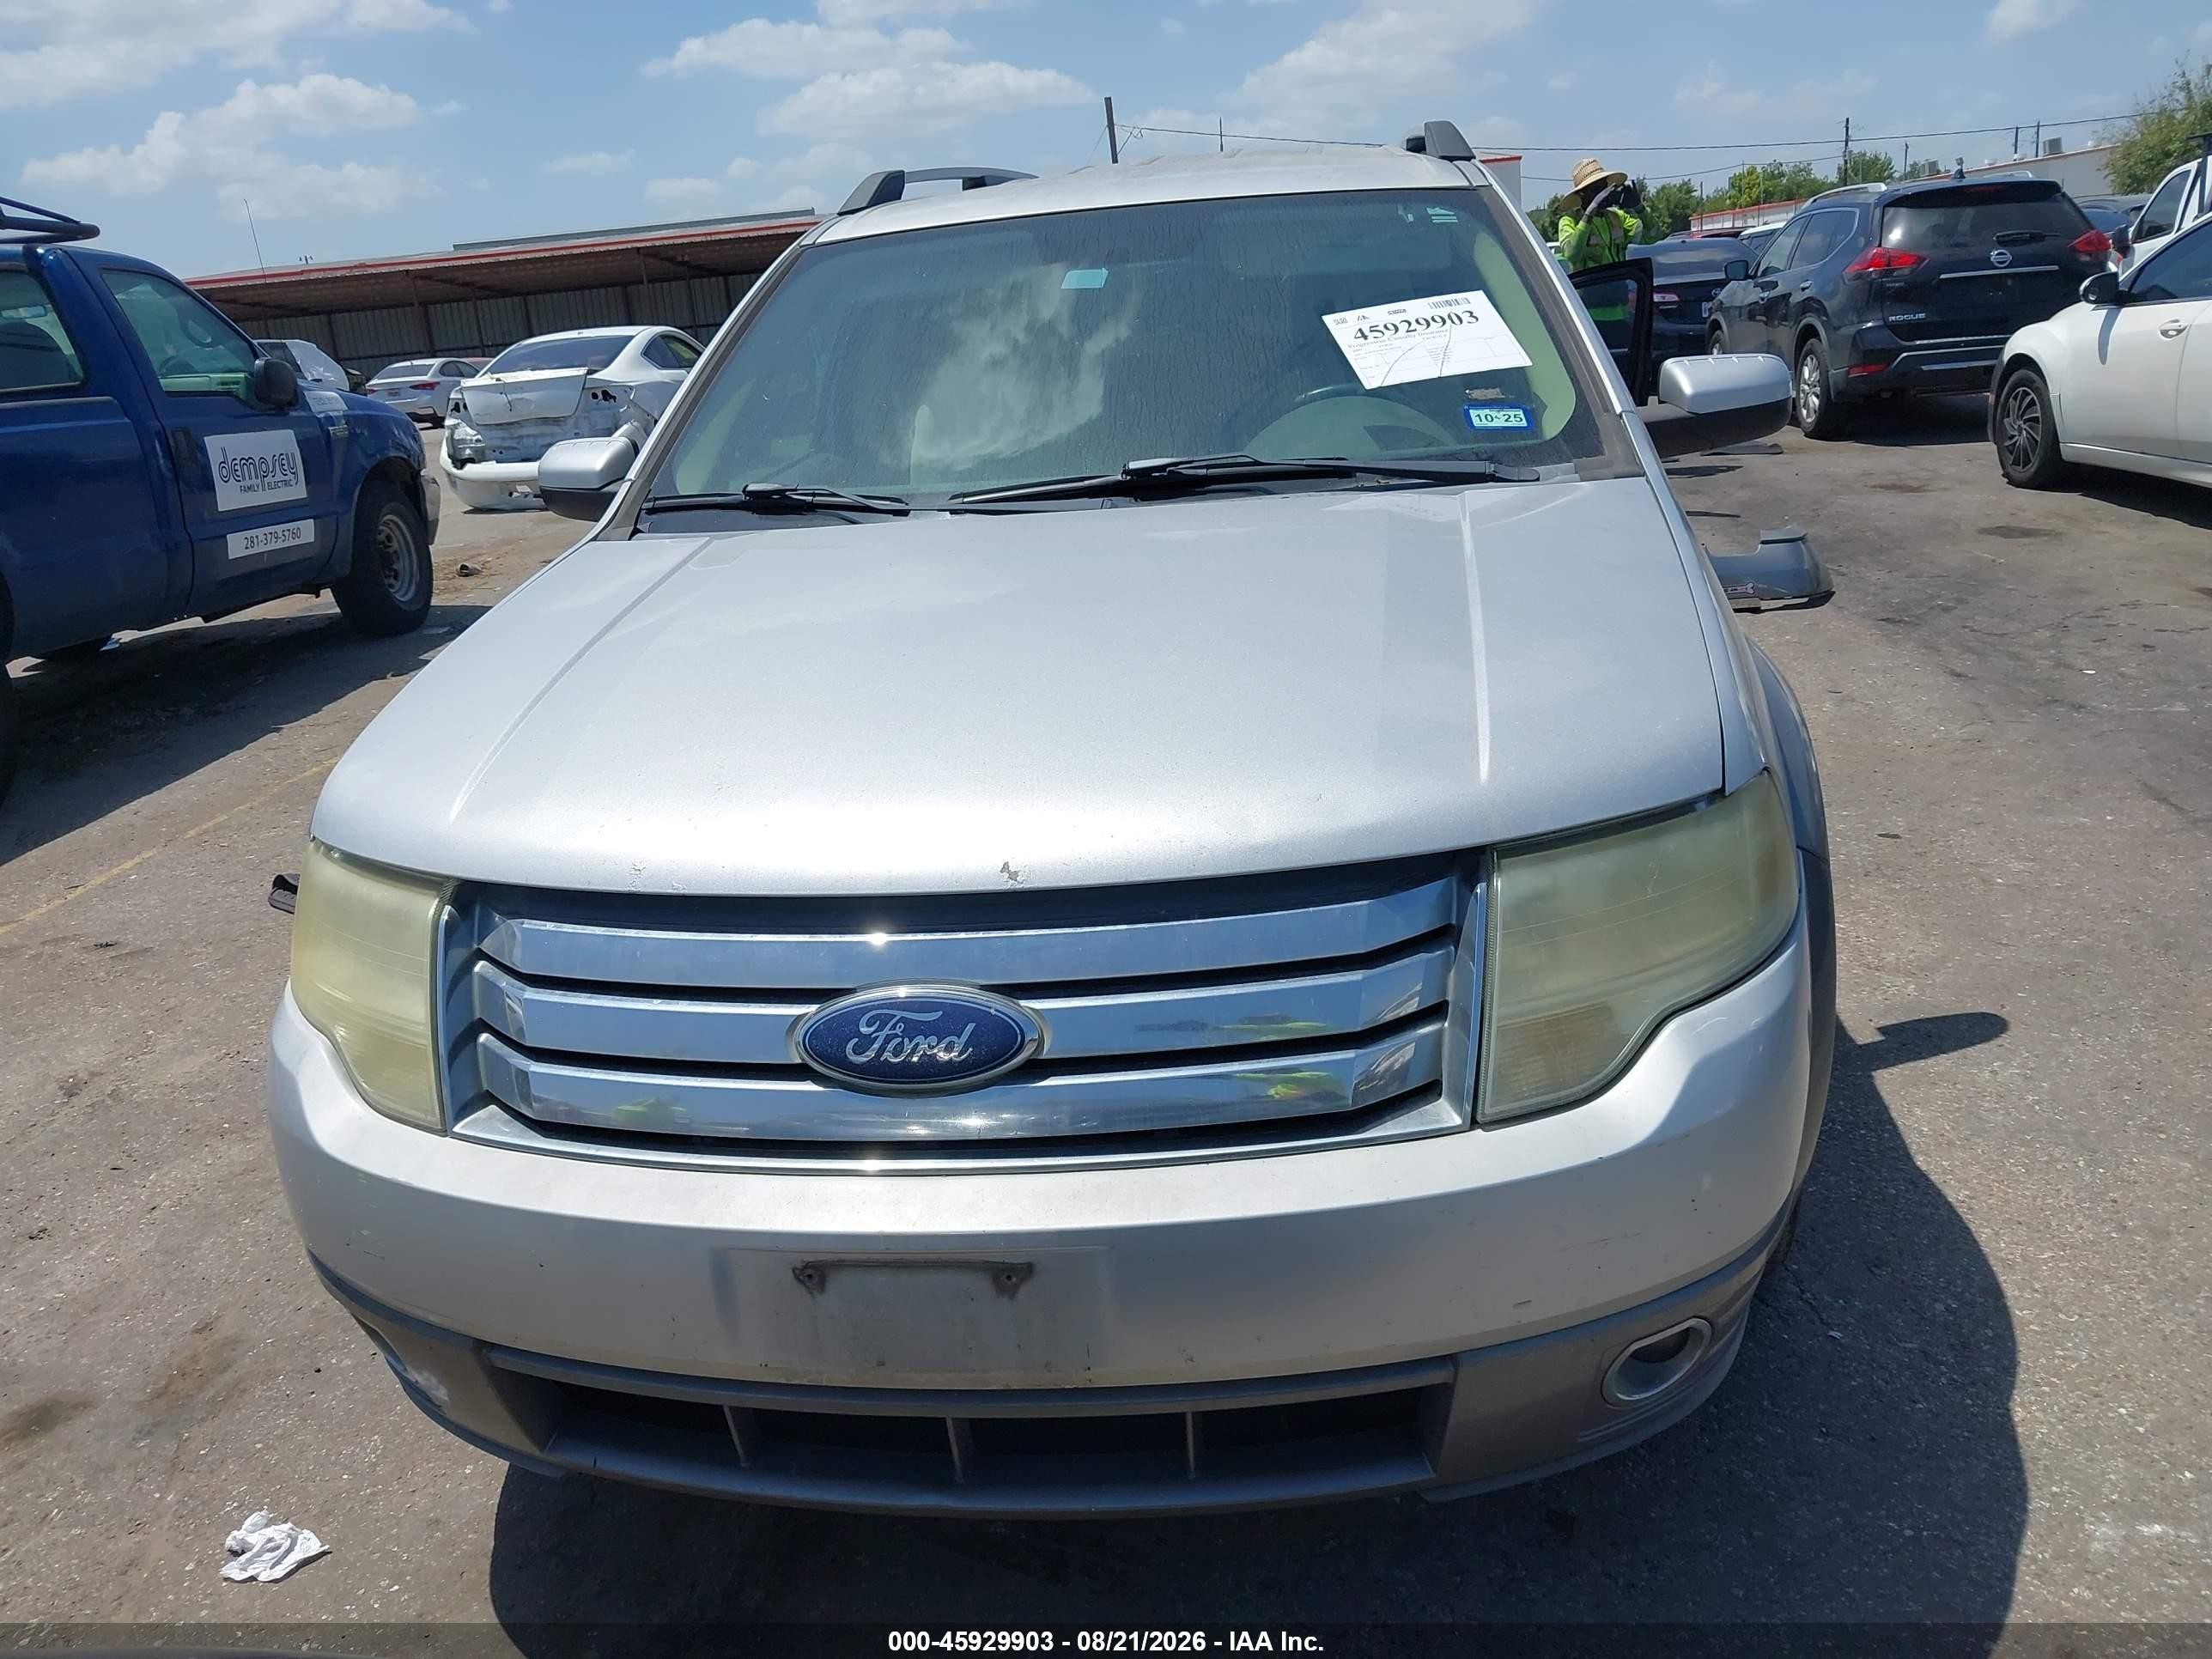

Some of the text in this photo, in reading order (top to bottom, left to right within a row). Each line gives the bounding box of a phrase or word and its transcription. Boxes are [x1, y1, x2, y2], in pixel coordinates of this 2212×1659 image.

[1353, 310, 1480, 341] 45929903
[1888, 313, 1926, 322] ROGUE
[218, 447, 299, 492] dempsey
[240, 478, 293, 494] FAMILY ELECTRIC
[244, 526, 301, 550] 281-379-5760
[845, 1008, 976, 1064] Ford
